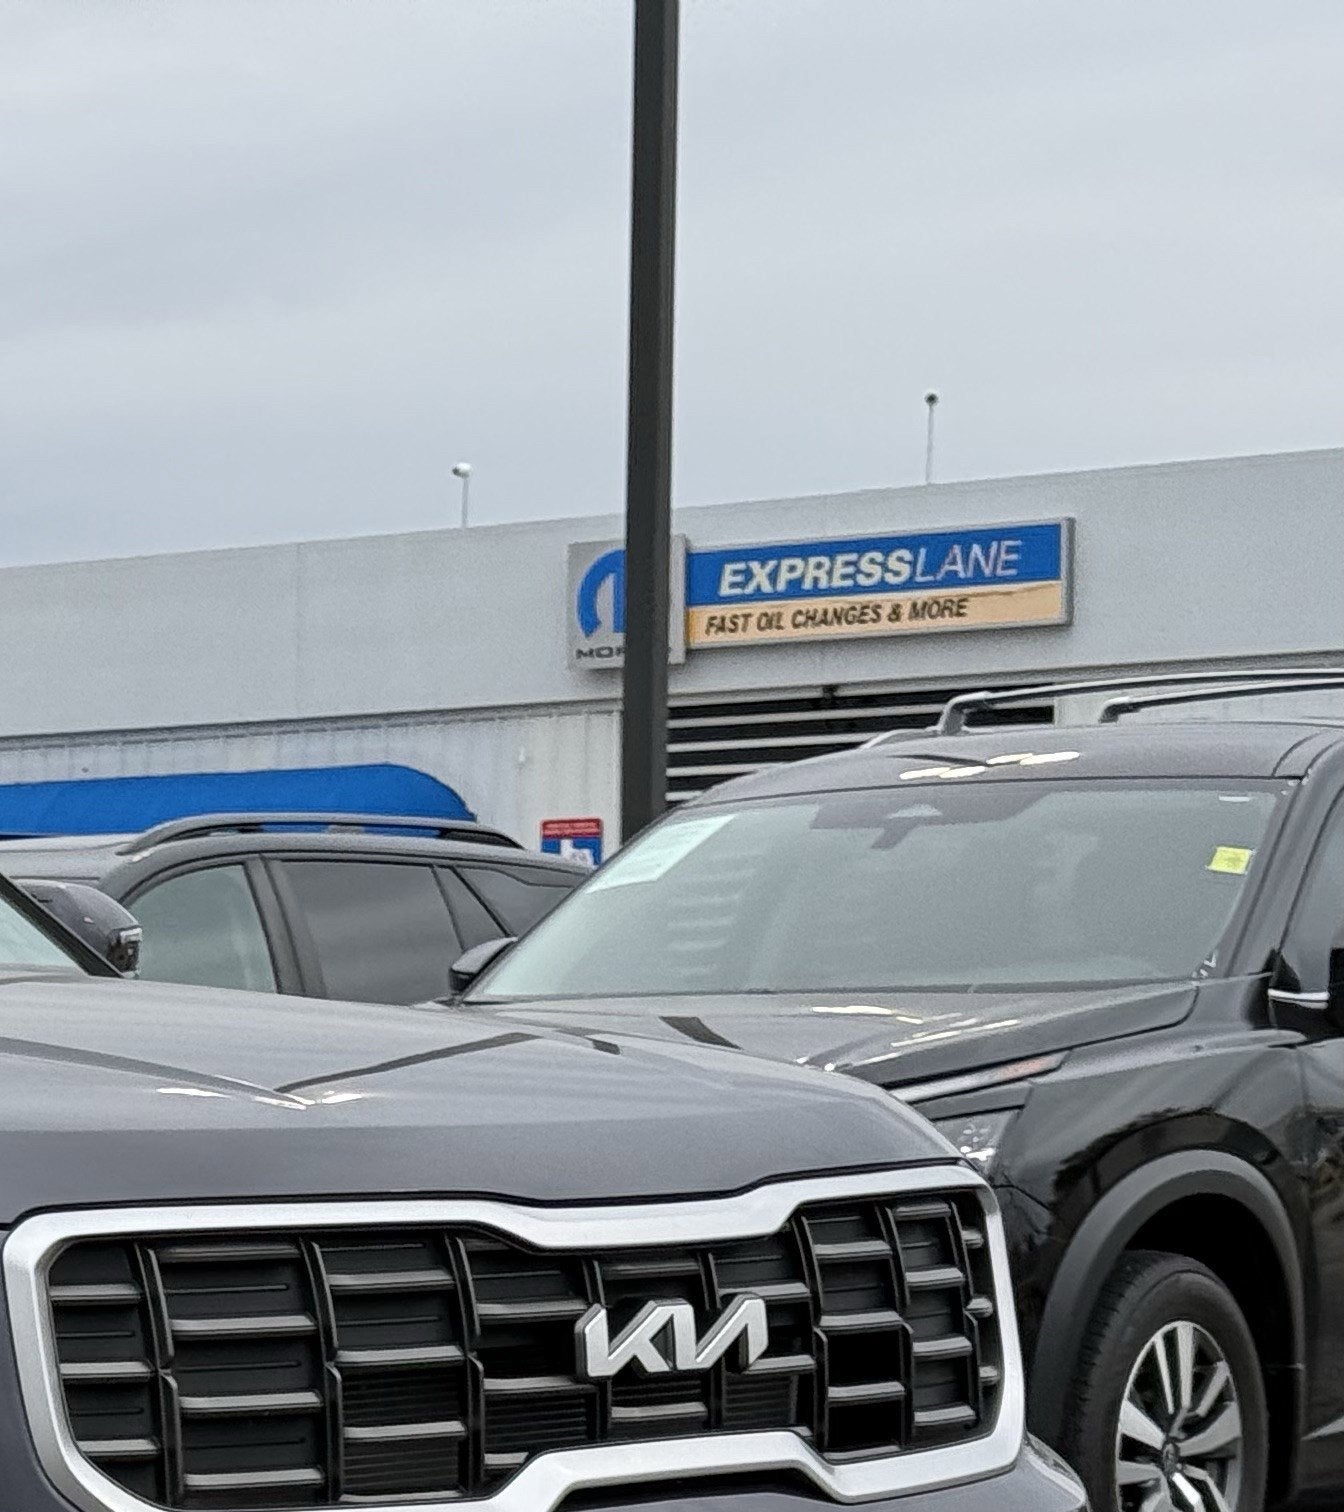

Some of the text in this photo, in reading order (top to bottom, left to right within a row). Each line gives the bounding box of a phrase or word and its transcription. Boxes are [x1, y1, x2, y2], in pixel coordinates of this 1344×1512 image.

[717, 539, 1023, 597] EXPRESSLANE
[704, 597, 969, 637] FAST OIL CHANGES & MORE
